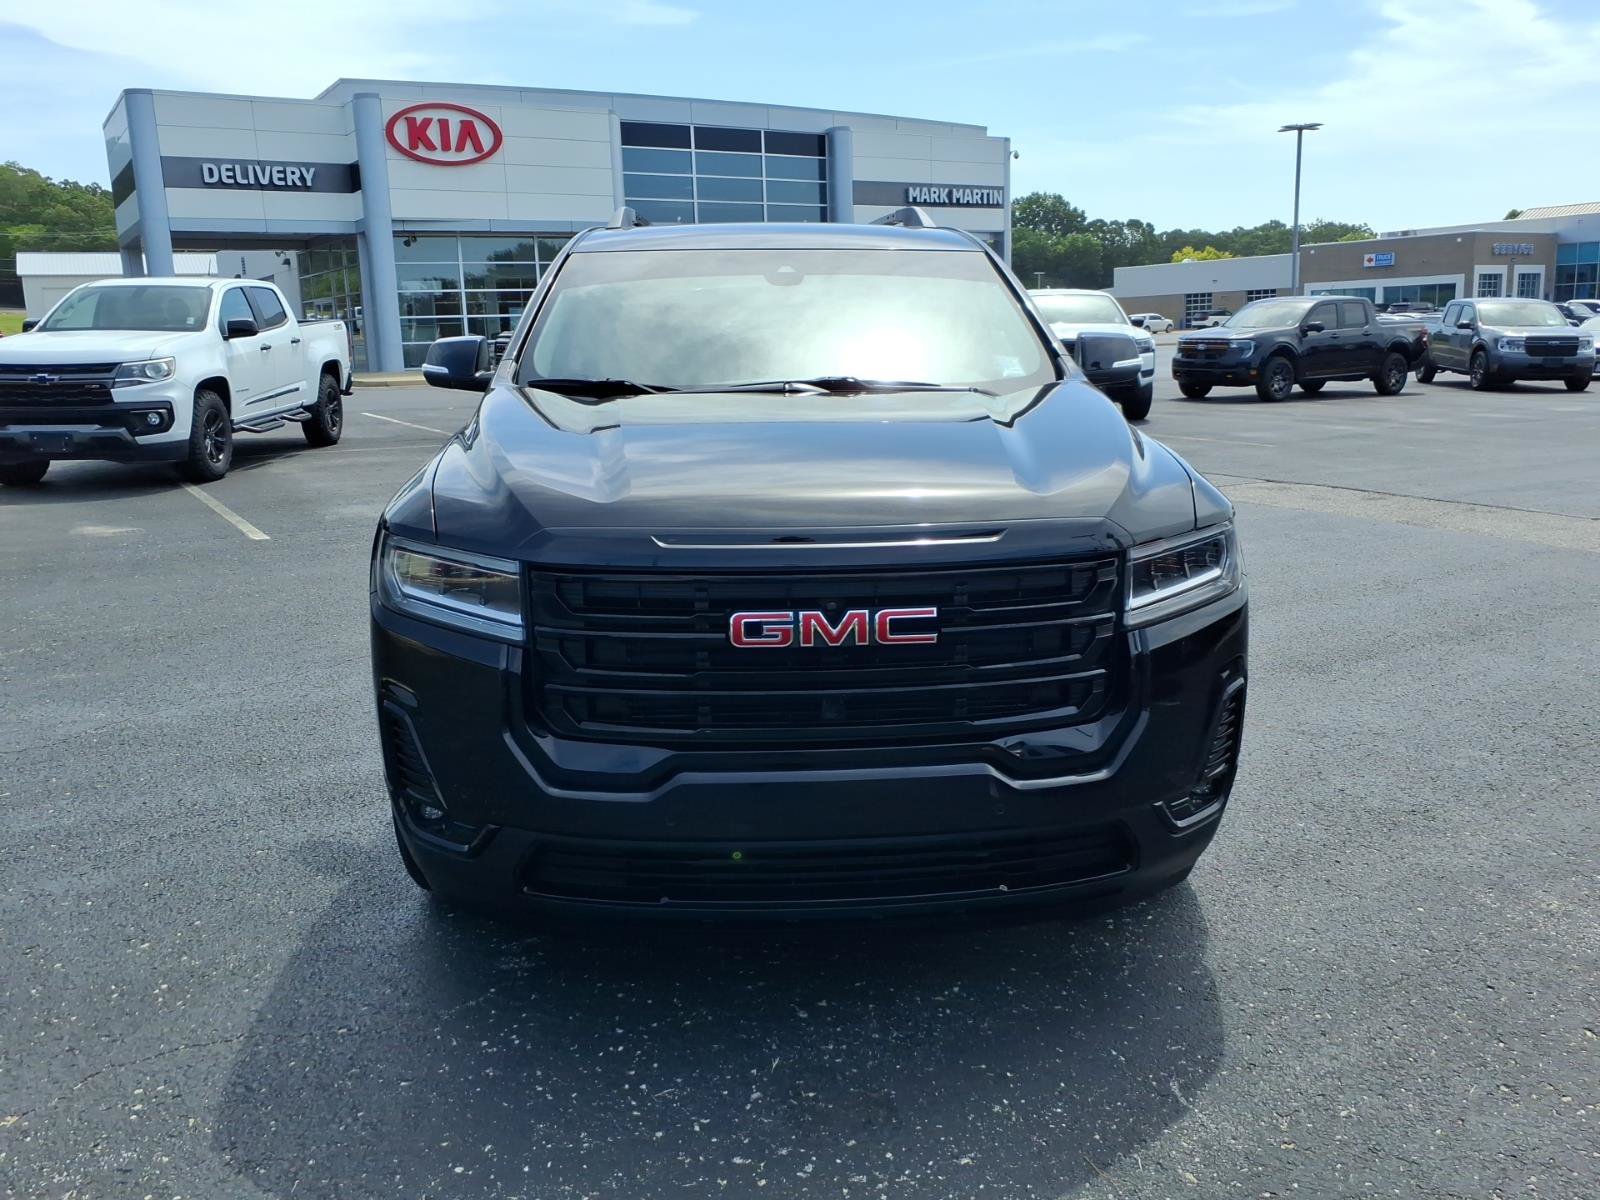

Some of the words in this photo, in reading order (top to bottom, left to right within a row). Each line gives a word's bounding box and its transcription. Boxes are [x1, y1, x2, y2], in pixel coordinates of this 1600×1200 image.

[404, 116, 485, 153] KIA
[201, 163, 315, 187] DELIVERY
[908, 186, 950, 203] MARK
[952, 188, 1003, 205] MARTIN
[730, 607, 938, 648] GMC
